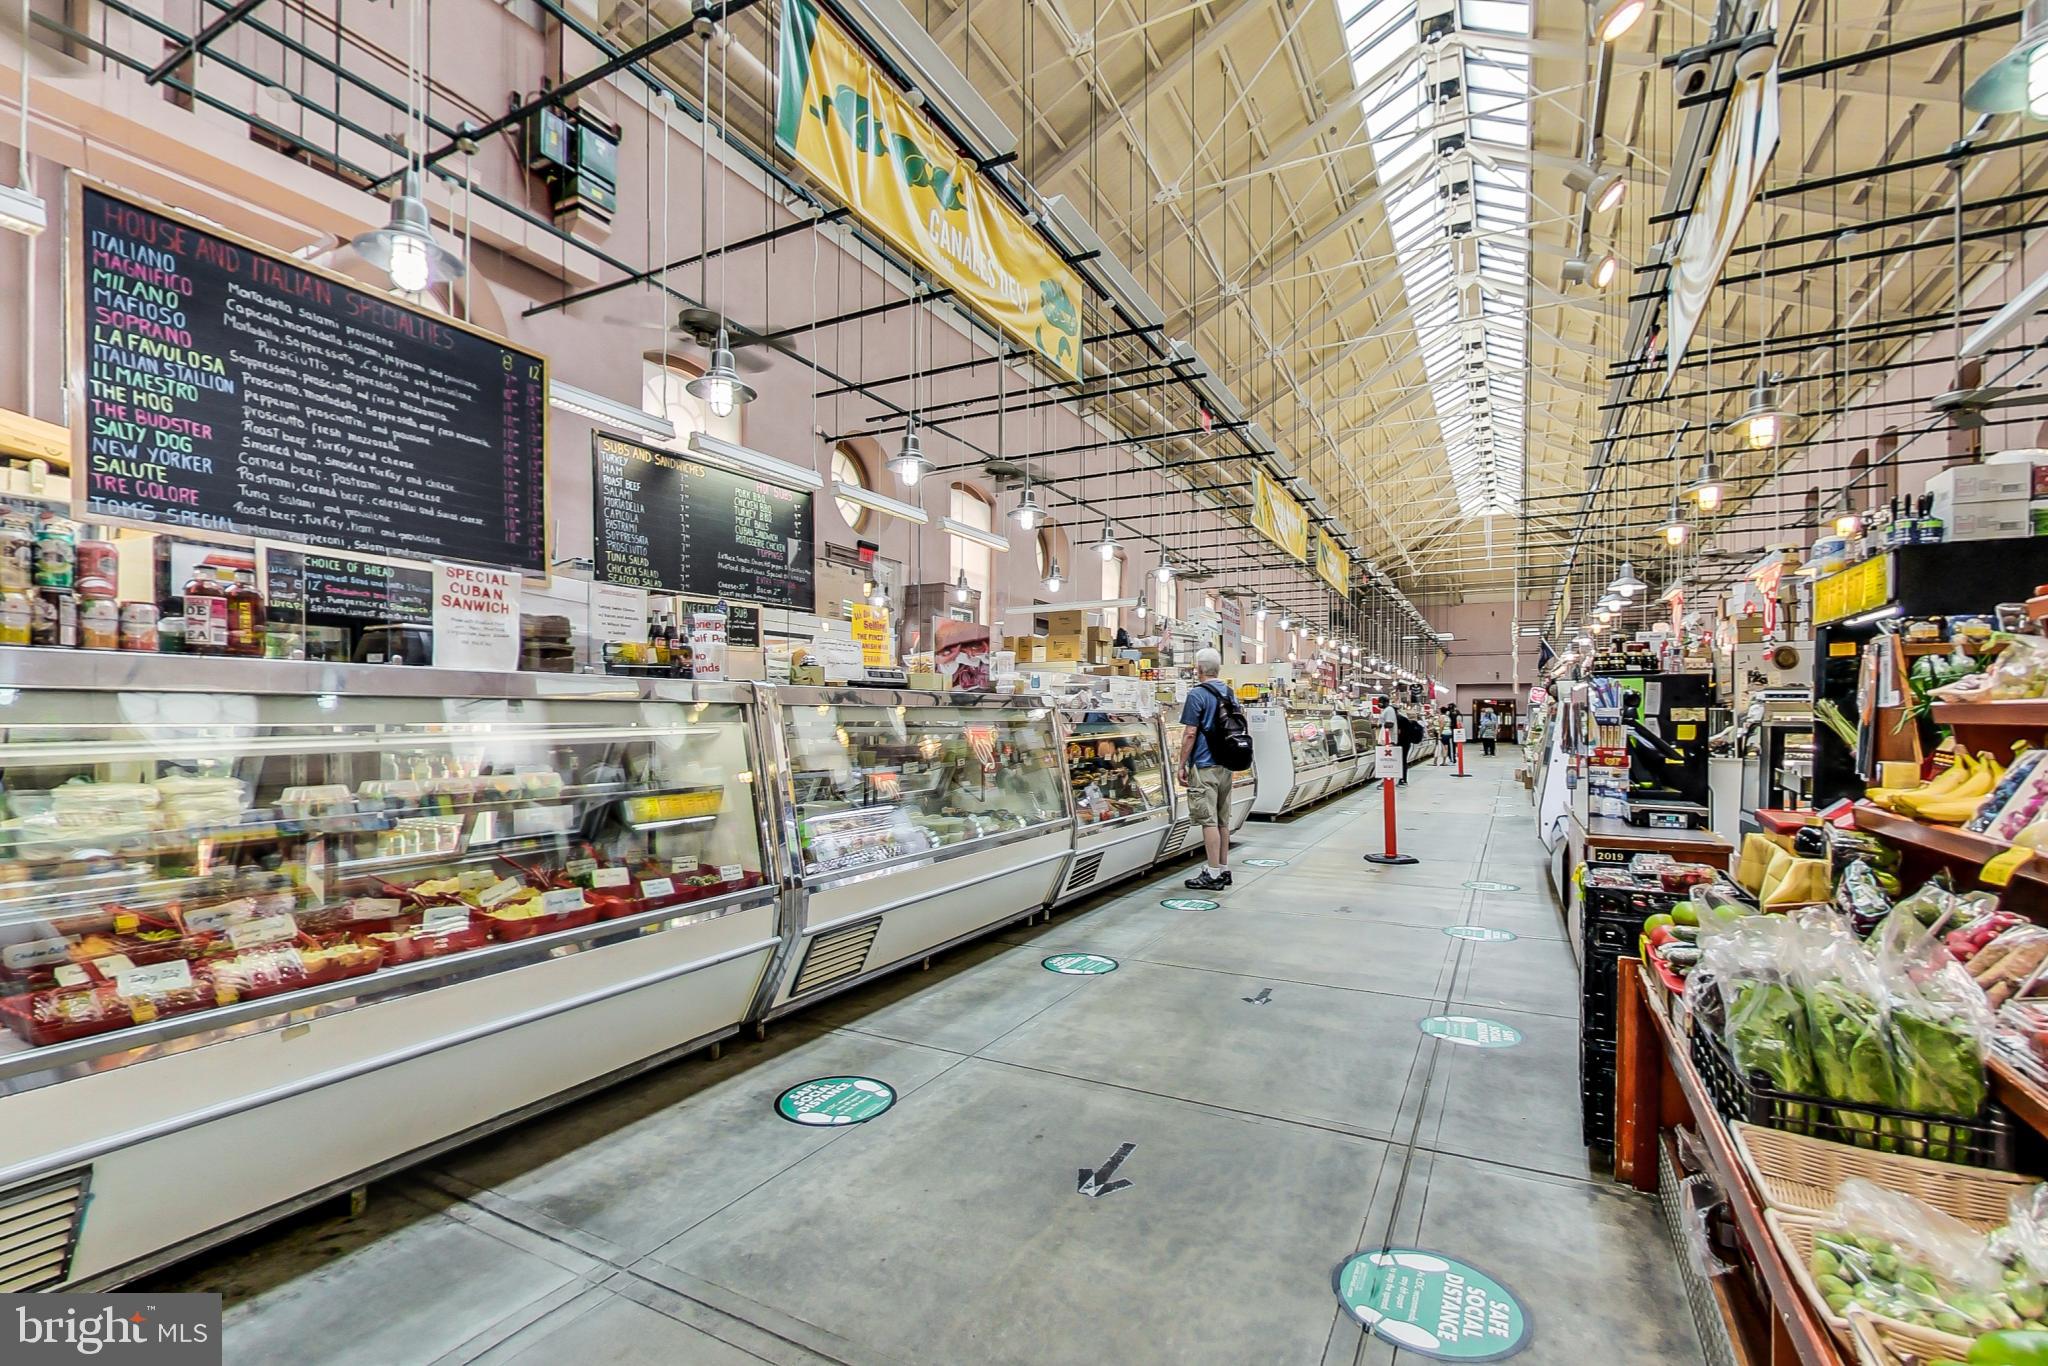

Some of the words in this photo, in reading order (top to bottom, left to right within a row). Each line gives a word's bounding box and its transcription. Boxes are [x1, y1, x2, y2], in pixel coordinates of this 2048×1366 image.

[92, 230, 175, 273] ITALIANO
[92, 249, 192, 296] MAGNIFICO
[104, 202, 187, 256] HOUSE
[195, 237, 240, 273] AND
[251, 256, 332, 305] ITALIAN
[346, 292, 454, 349] SPECIALTIES
[93, 268, 178, 309] MILANO
[94, 287, 186, 328] MAFIOSO
[298, 308, 339, 329] Salami
[96, 306, 192, 348] SOPRANO
[95, 325, 123, 348] LA
[128, 333, 225, 376] FAVULOSA
[93, 343, 158, 375] ITALIAN
[164, 362, 235, 395] STALLION
[93, 361, 112, 381] IL
[116, 366, 199, 402] MAESTRO
[90, 379, 127, 403] THE
[133, 390, 173, 413] HOG
[91, 399, 128, 421] THE
[135, 408, 213, 440] BUDSTER
[241, 419, 280, 439] Roast
[93, 417, 147, 444] SALTY
[155, 430, 193, 453] DOG
[92, 437, 138, 459] NEW
[146, 447, 213, 475] YORKER
[241, 436, 291, 458] Smoked
[93, 455, 169, 484] SALUTE
[600, 451, 629, 467] TURKEY
[602, 440, 630, 457] SUBS
[632, 447, 652, 463] AND
[654, 453, 706, 478] SANDWICHES
[602, 463, 623, 476] HAM
[91, 472, 130, 495] TRE
[602, 474, 624, 487] ROAST
[625, 479, 641, 491] BEEF
[602, 485, 633, 501] SALAMI
[90, 495, 157, 521] TOM'S
[166, 508, 241, 533] SPECIAL
[603, 507, 639, 523] CAPICOLA
[734, 497, 759, 511] CHICKEN
[604, 518, 637, 533] PASTRAMI
[605, 550, 627, 563] TUNA
[628, 554, 650, 567] SALAD
[756, 548, 784, 560] TOPPINGS
[304, 556, 342, 571] CHOICE
[347, 561, 358, 572] OF
[364, 565, 395, 578] BREAD
[446, 566, 509, 586] SPECIAL
[606, 563, 637, 576] CHICKEN
[639, 568, 659, 579] SALAD
[449, 581, 503, 600] CUBAN
[607, 573, 640, 586] SEAFOOD
[642, 578, 663, 588] SALAD
[441, 594, 509, 614] SANWICH
[734, 608, 748, 618] SUB
[1597, 852, 1624, 861] 2019
[788, 1083, 821, 1100] SAFE
[793, 1083, 836, 1107] SOCIAL
[797, 1082, 853, 1113] DISTANCE
[1437, 1272, 1465, 1343] DISTANCE
[1462, 1286, 1487, 1338] SOCIAL
[1487, 1300, 1510, 1338] SAFE
